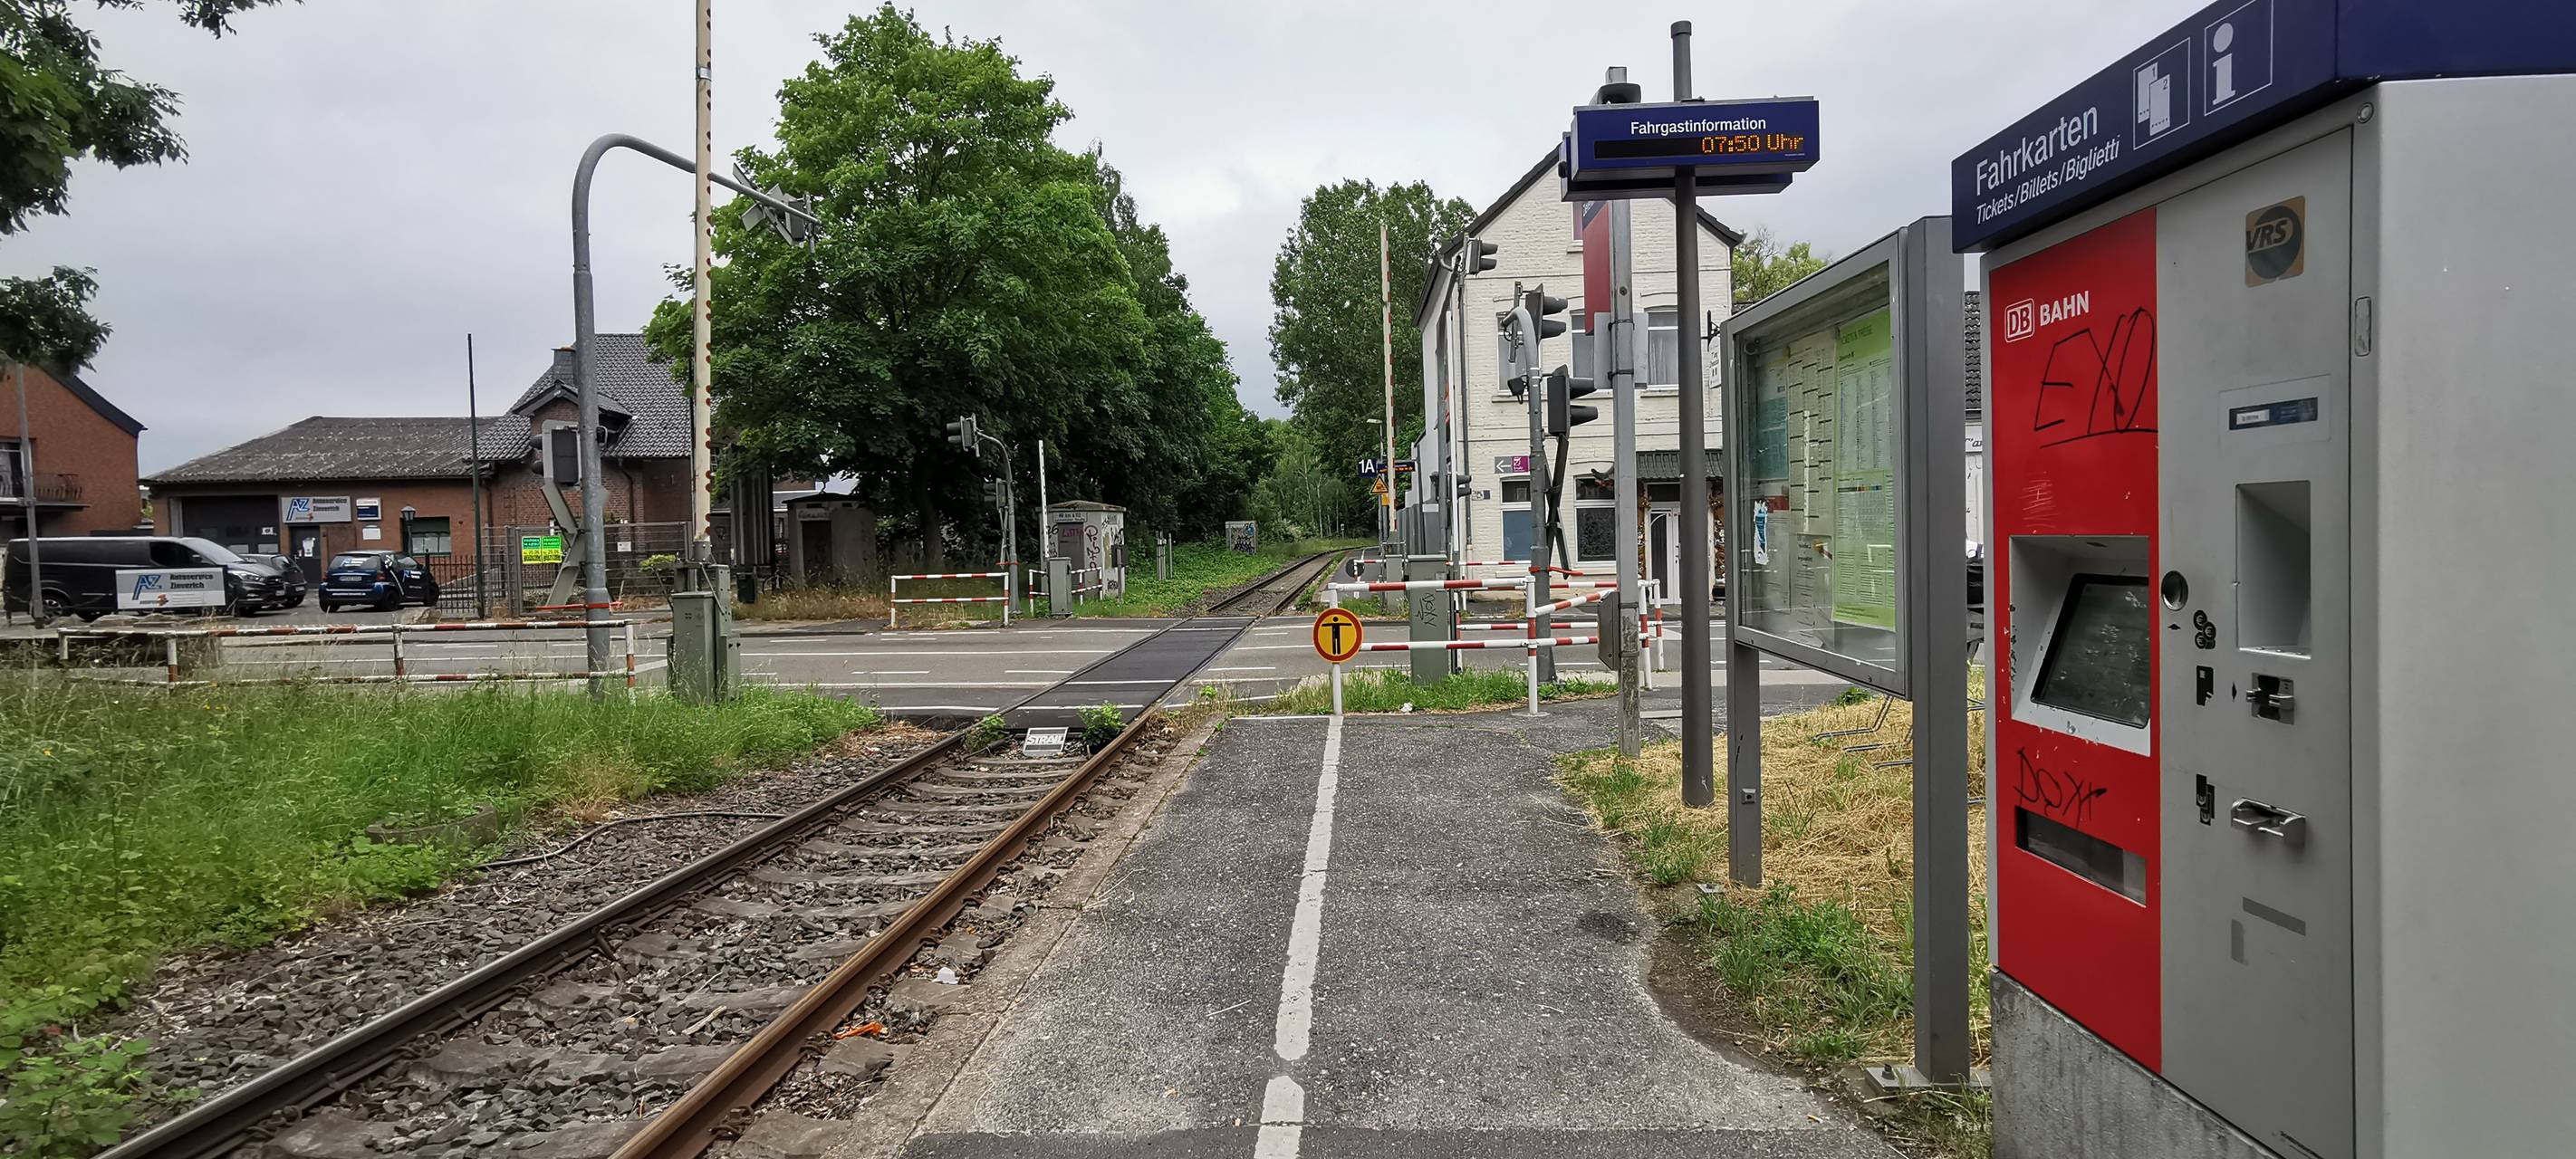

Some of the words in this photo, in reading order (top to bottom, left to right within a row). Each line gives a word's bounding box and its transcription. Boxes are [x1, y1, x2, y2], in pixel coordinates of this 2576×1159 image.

[1630, 117, 1766, 136] Fahrgastinformation
[1701, 136, 1760, 153] 07:50
[1767, 134, 1803, 150] Uhr
[1976, 106, 2098, 196] Fahrkarten
[2245, 219, 2287, 252] VRS
[2006, 302, 2033, 340] DB
[2040, 290, 2090, 327] BAHN
[1359, 458, 1375, 474] 1A
